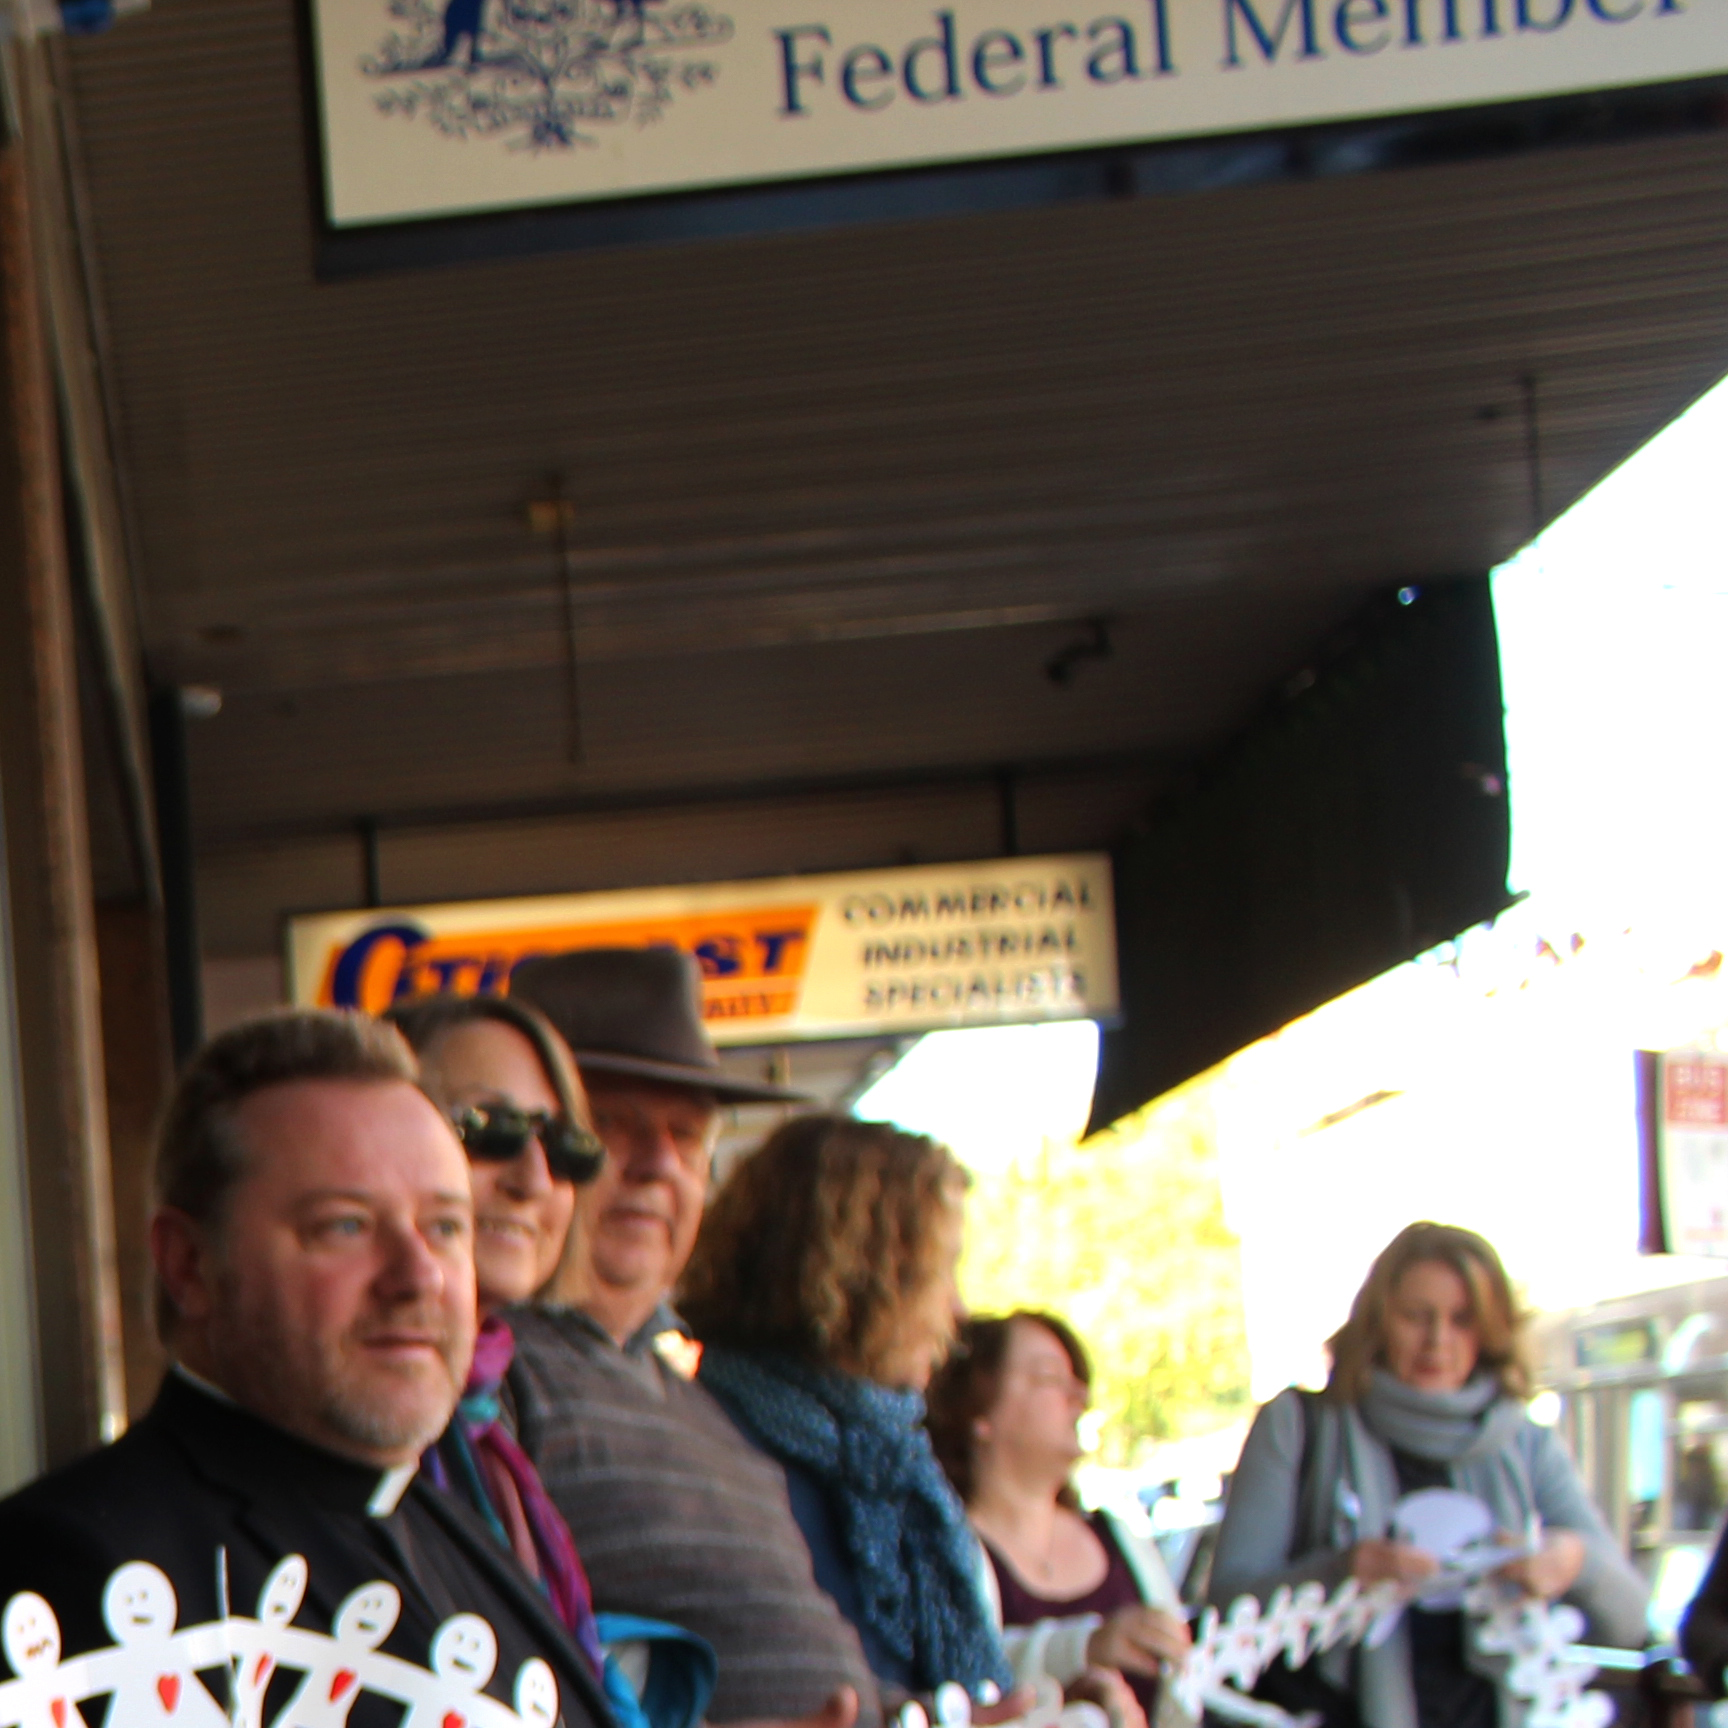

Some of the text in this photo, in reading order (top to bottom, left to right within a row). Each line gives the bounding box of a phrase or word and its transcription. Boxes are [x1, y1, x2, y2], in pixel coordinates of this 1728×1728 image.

[771, 0, 1688, 118] Federal Mem
[841, 880, 1092, 928] COMMERCIAL
[863, 927, 1077, 970] INDUSTRIAL
